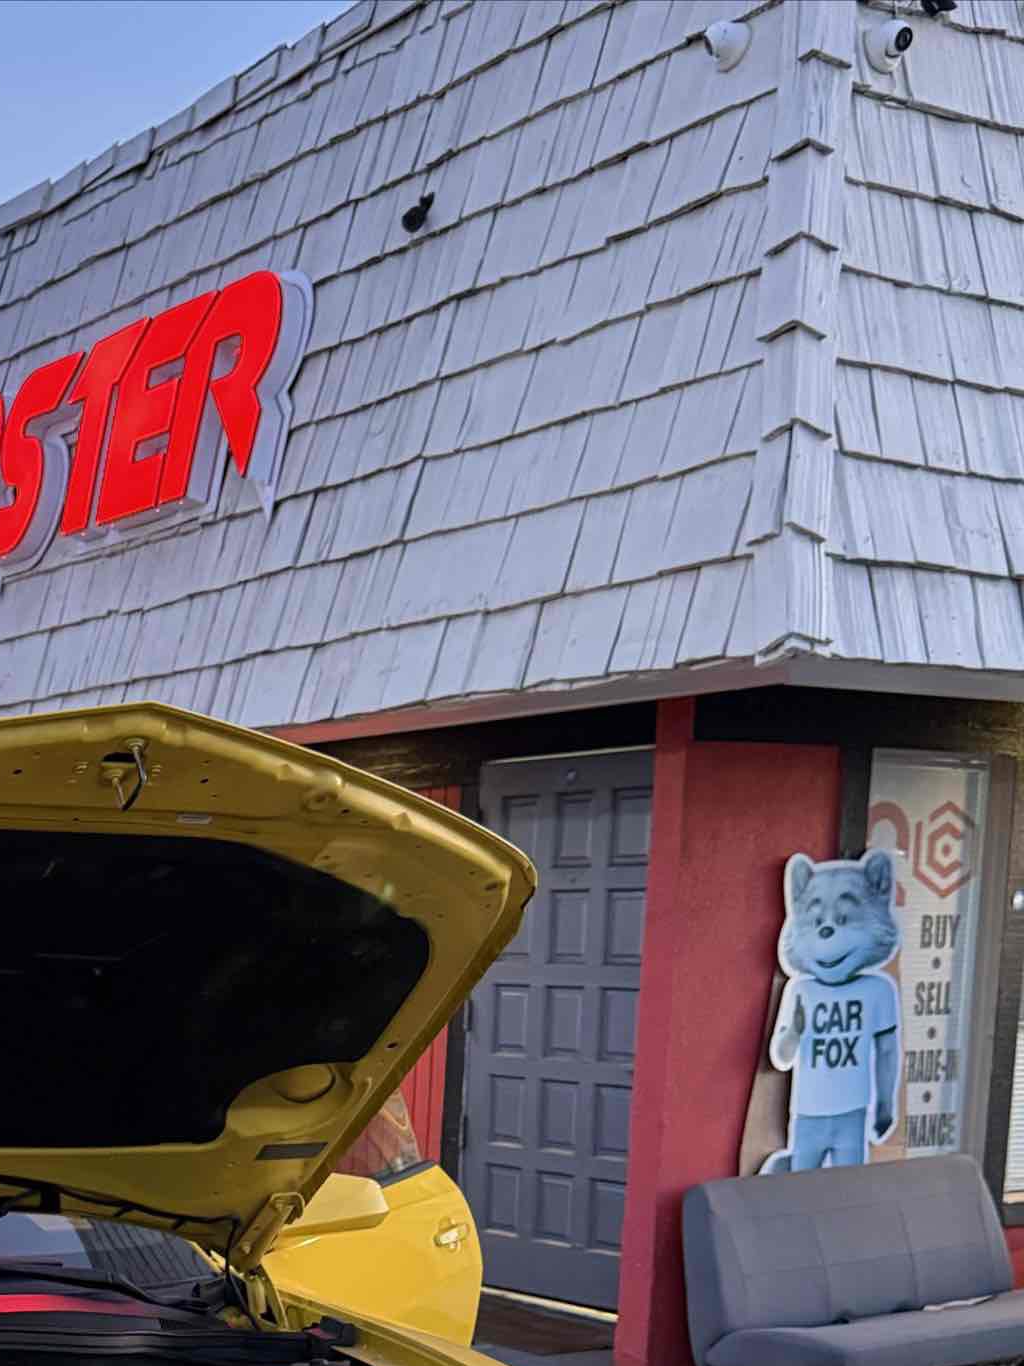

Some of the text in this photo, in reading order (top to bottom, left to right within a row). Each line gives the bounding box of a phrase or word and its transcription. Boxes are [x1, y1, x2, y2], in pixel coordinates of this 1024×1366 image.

[920, 914, 961, 949] BUY
[914, 981, 951, 1016] SELL
[812, 1000, 863, 1033] CAR
[811, 1036, 859, 1069] FOX
